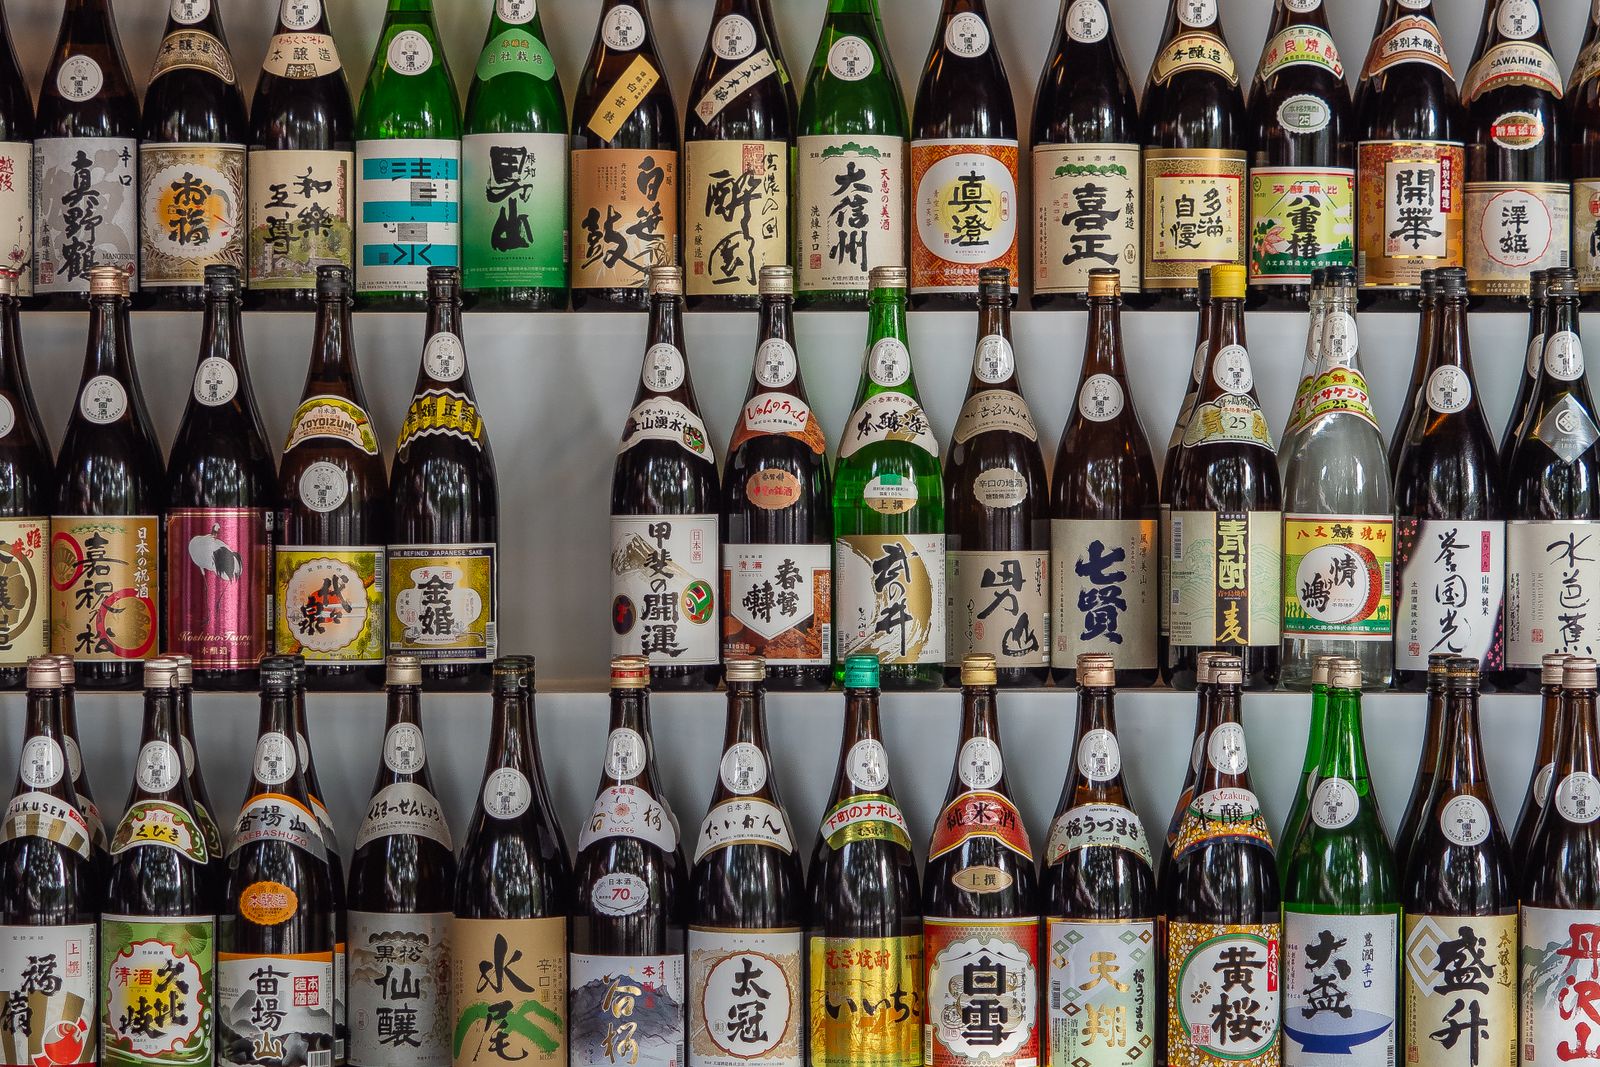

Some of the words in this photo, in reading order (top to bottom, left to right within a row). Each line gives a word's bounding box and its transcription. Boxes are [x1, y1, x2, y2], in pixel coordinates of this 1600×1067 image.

[162, 38, 212, 54] 本醸造
[270, 47, 332, 62] 本醸造
[487, 51, 543, 65] 自社栽培
[502, 39, 529, 48] 本醸造
[1171, 45, 1222, 62] 本醸造
[1388, 35, 1442, 56] 特別本醸造
[1490, 56, 1543, 69] SAWAHIME
[602, 82, 639, 125] 白笹鼓
[1299, 115, 1311, 126] 25
[119, 146, 132, 187] 辛口
[486, 146, 535, 252] 男山
[880, 169, 891, 231] 天恵の美酒
[1441, 158, 1451, 211] 特別本醸造
[828, 161, 874, 272] 大信州
[947, 170, 993, 247] 真澄
[1061, 182, 1121, 266] 喜正
[1124, 187, 1135, 230] 本醸造
[1389, 169, 1442, 250] 開華
[41, 222, 51, 262] 本醸造
[811, 205, 822, 252] 洗練辛口
[1285, 195, 1322, 260] 八重椿
[747, 398, 807, 424] しゅんのうてん
[1311, 387, 1369, 405] ナサケシマ
[1332, 399, 1348, 410] 25
[300, 417, 356, 432] YOYOIZUMI
[857, 411, 927, 440] 本醸造
[1228, 416, 1247, 430] 25
[979, 479, 1024, 488] 辛口の地酒
[877, 501, 904, 510] 上撰
[692, 530, 702, 561] 日本酒
[1217, 521, 1248, 590] 青酎
[133, 527, 150, 599] 日本の祝酒
[418, 575, 454, 636] 金婚
[639, 521, 689, 658] 甲斐の開運
[1075, 540, 1128, 644] 七賢
[1546, 533, 1596, 654] 水芭蕉
[1215, 600, 1249, 645] 麦
[1410, 581, 1419, 640] 土田酒造株式会社
[610, 787, 636, 796] 本醸造
[1211, 791, 1252, 802] Kizakura
[9, 802, 67, 819] FUKUSEN
[238, 805, 307, 833] 苗場山
[727, 803, 752, 813] 日本酒
[946, 801, 1017, 833] 純米酒
[135, 824, 180, 843] くびき
[608, 826, 635, 834] たにざくら
[704, 813, 782, 837] たいかん
[611, 888, 631, 900] 70
[969, 872, 997, 887] 上撰
[249, 893, 289, 908] 本醸造
[67, 942, 80, 976] 上撰
[374, 946, 423, 963] 黒松
[826, 949, 891, 972] むぎ焼酎
[1361, 933, 1374, 989] 豊潤辛口
[1497, 930, 1512, 987] 本醸造
[115, 966, 152, 987] 清酒
[537, 958, 552, 988] 辛口
[1301, 929, 1353, 1020] 大盃
[248, 965, 292, 1060] 苗場山
[476, 932, 535, 1063] 水尾
[727, 957, 772, 1043] 太冠
[961, 955, 1011, 1048] 白雪
[1079, 951, 1131, 1048] 天翔
[1211, 947, 1267, 1046] 黄桜
[1429, 926, 1497, 1067] 盛升
